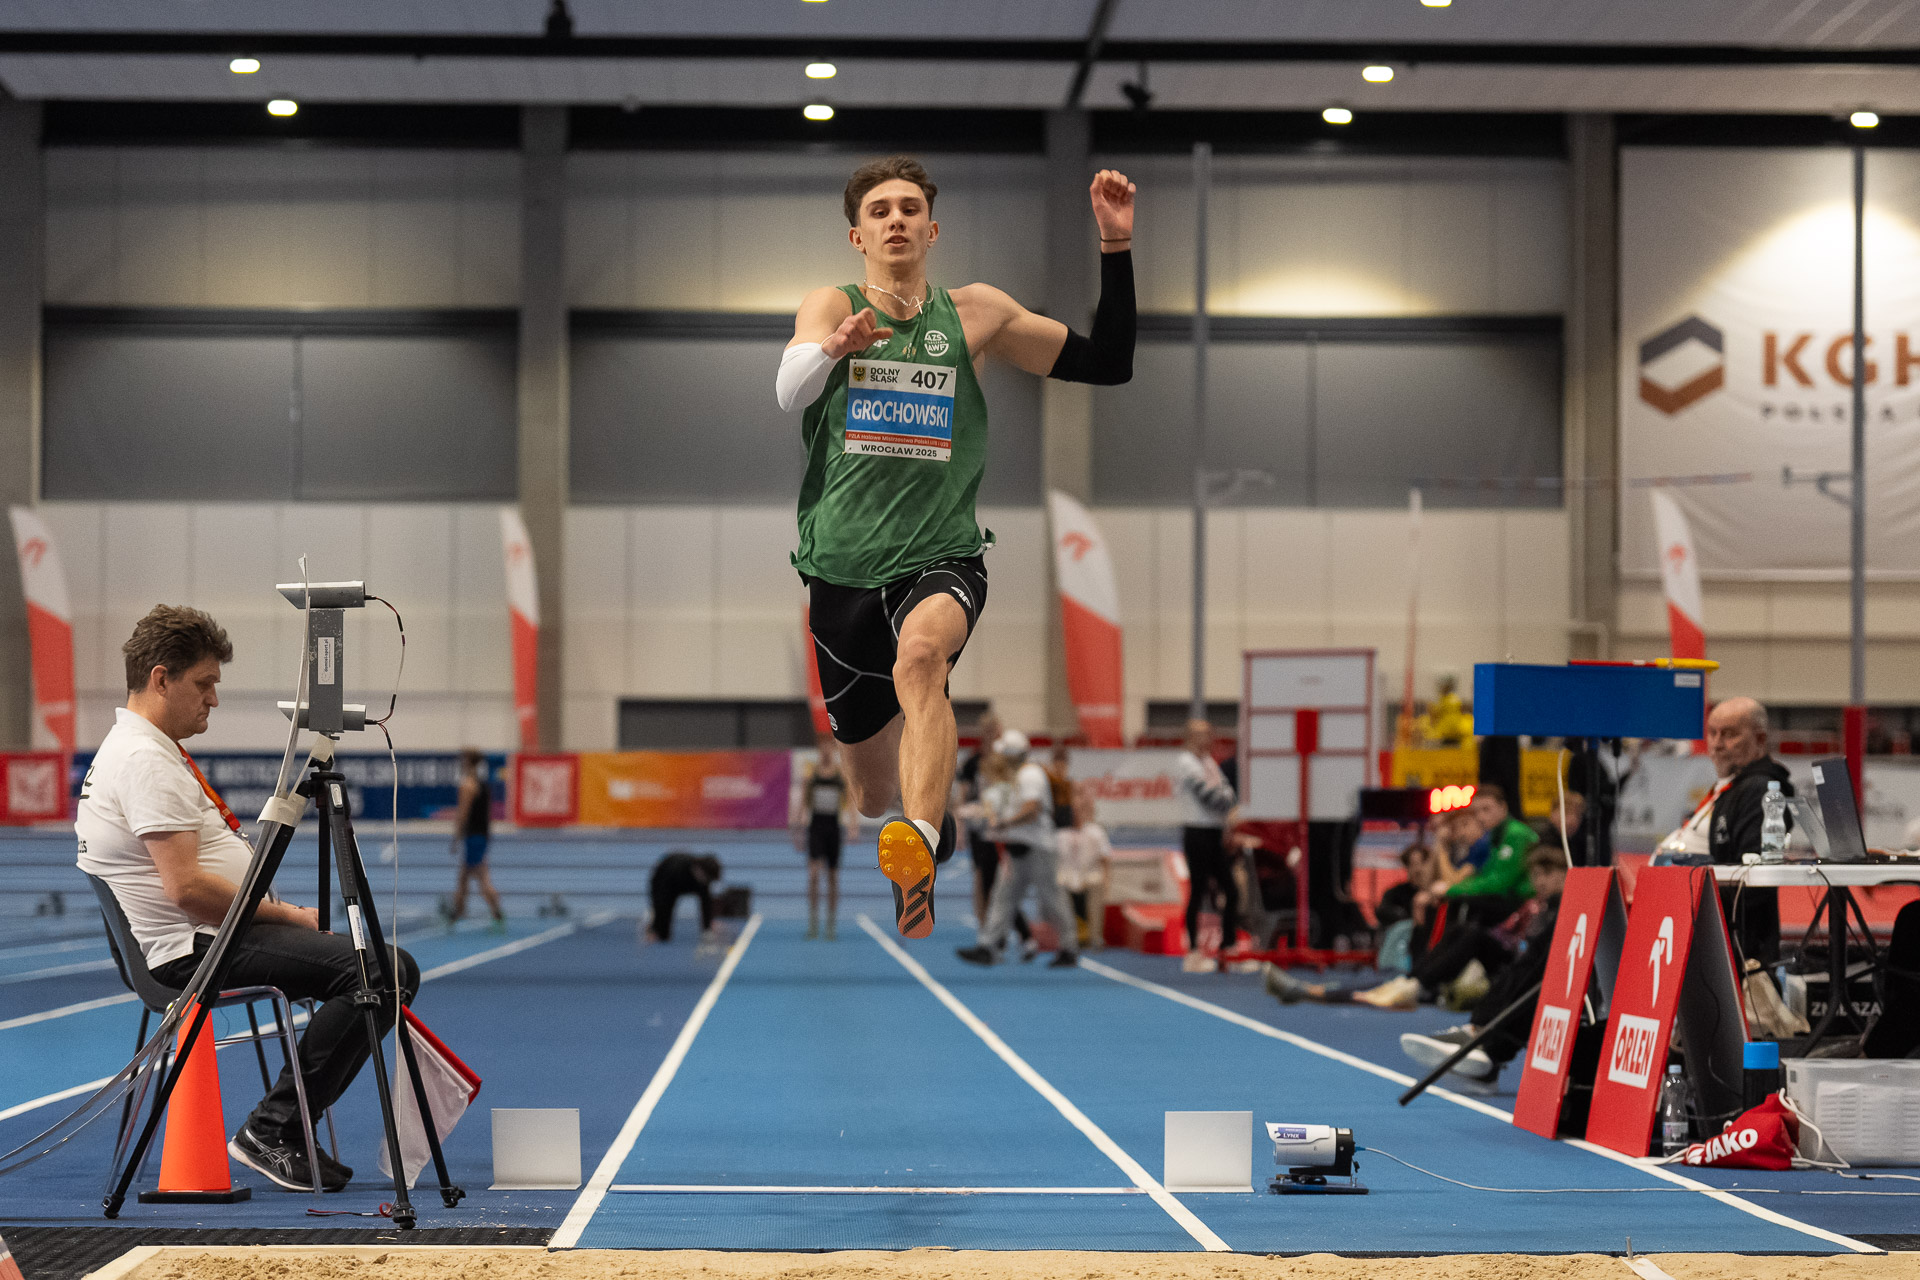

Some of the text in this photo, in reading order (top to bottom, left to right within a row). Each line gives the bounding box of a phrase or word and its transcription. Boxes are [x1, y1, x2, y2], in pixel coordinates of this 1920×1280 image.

[870, 367, 901, 376] DOLNY
[910, 370, 948, 390] 407
[851, 398, 949, 428] GROCHOWSKI
[861, 444, 937, 457] WROCŁAW 2025
[1614, 1025, 1655, 1077] ORLEN
[1705, 1128, 1758, 1163] JAKO
